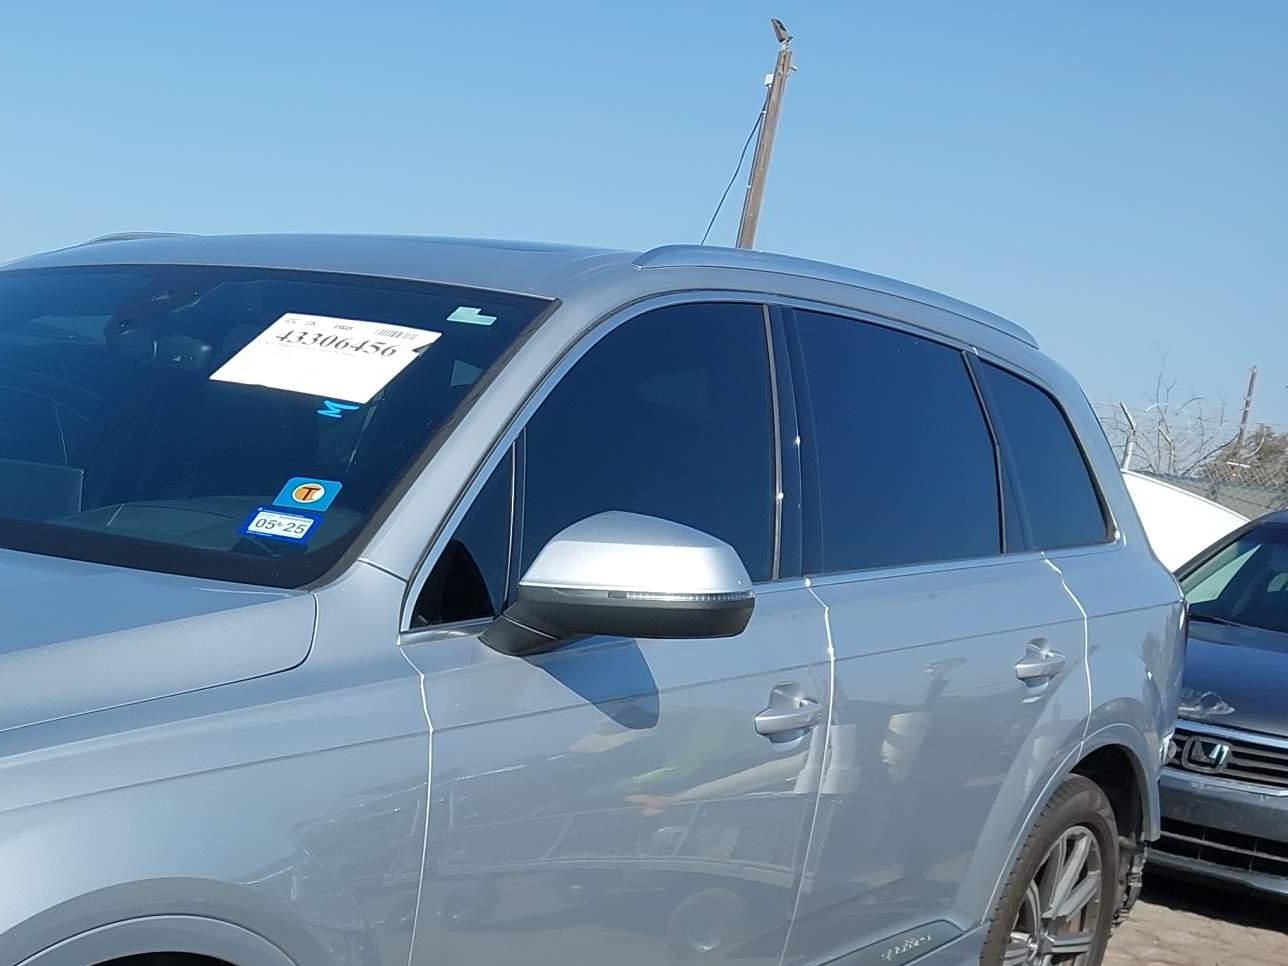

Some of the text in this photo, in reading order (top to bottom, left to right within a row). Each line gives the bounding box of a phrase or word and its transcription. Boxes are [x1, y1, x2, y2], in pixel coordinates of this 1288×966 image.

[275, 329, 397, 357] 43306456
[301, 486, 321, 501] T
[255, 518, 277, 530] 05
[282, 522, 307, 534] 25
